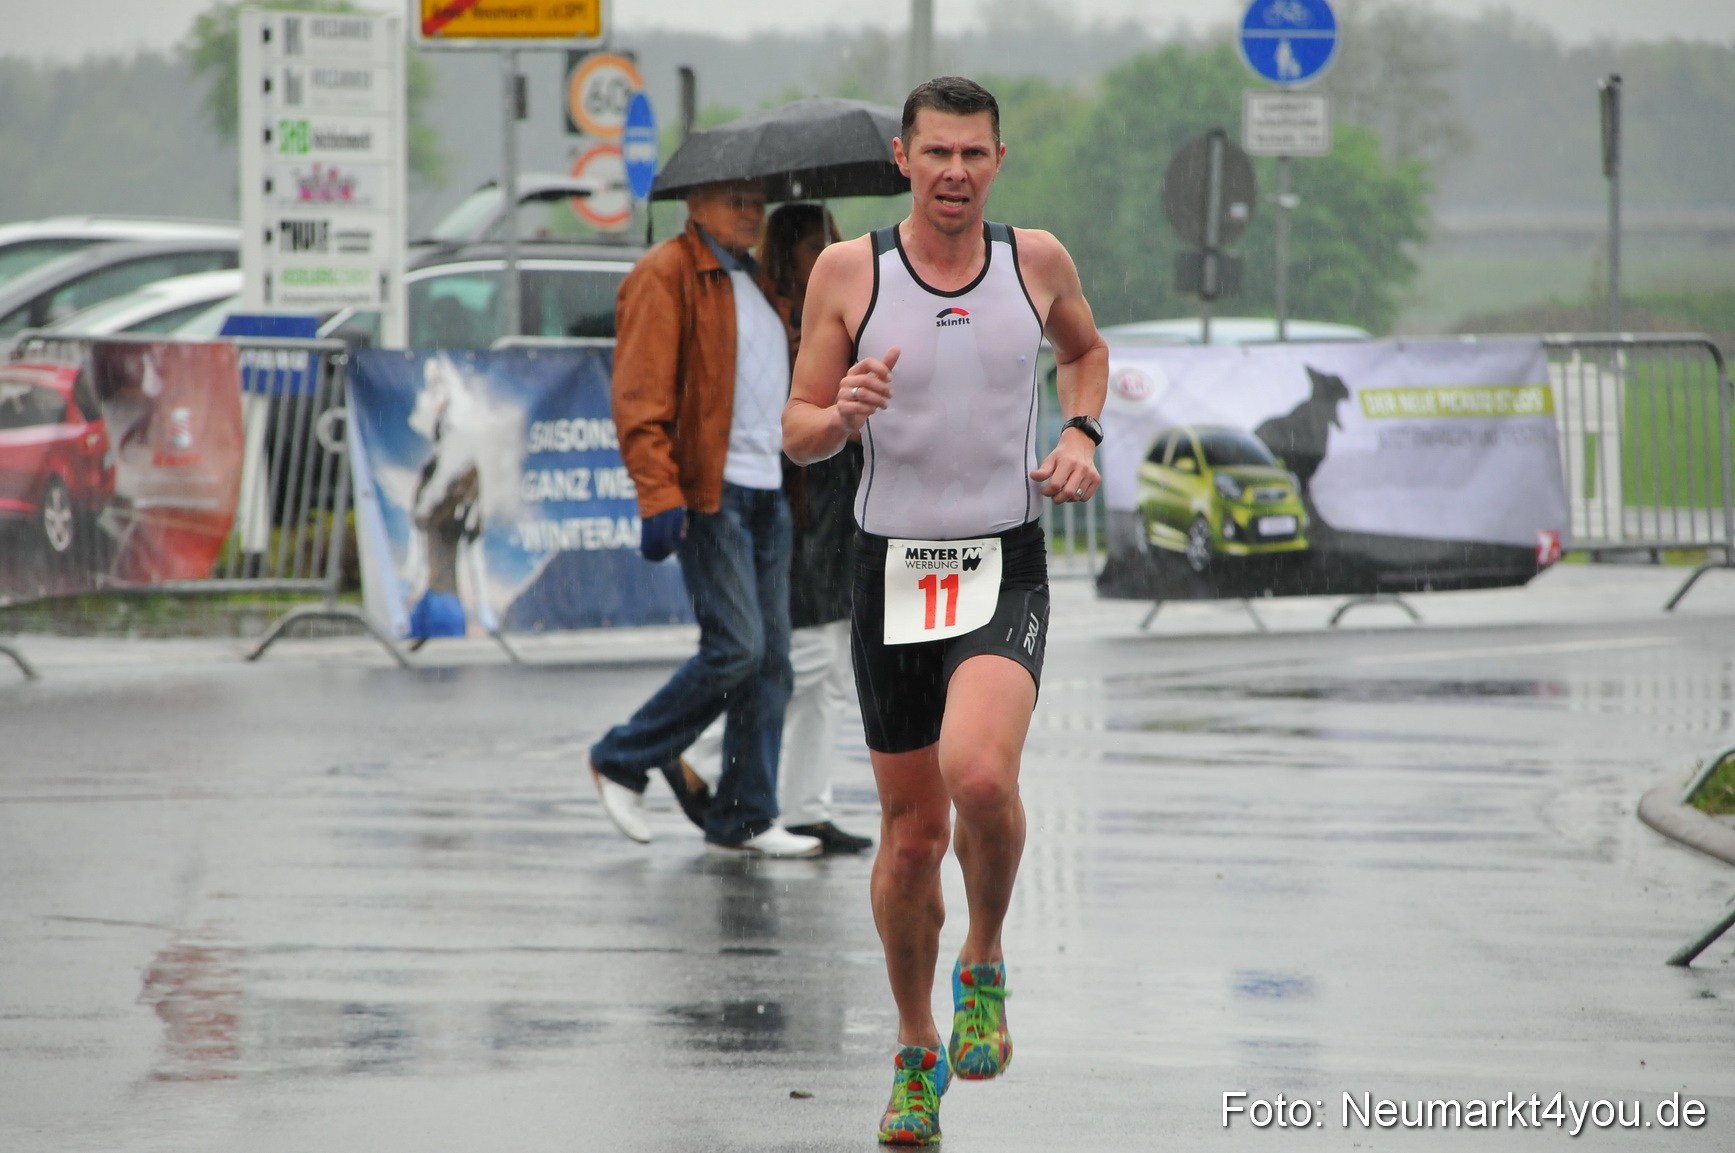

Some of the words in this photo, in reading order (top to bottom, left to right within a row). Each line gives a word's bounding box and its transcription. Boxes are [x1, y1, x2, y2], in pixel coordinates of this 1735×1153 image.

[936, 317, 970, 327] skinfit
[521, 468, 592, 502] GANZ
[904, 560, 959, 570] WERBUNG
[905, 547, 958, 560] MEYER
[918, 574, 959, 630] 11
[1023, 612, 1040, 656] 2XU
